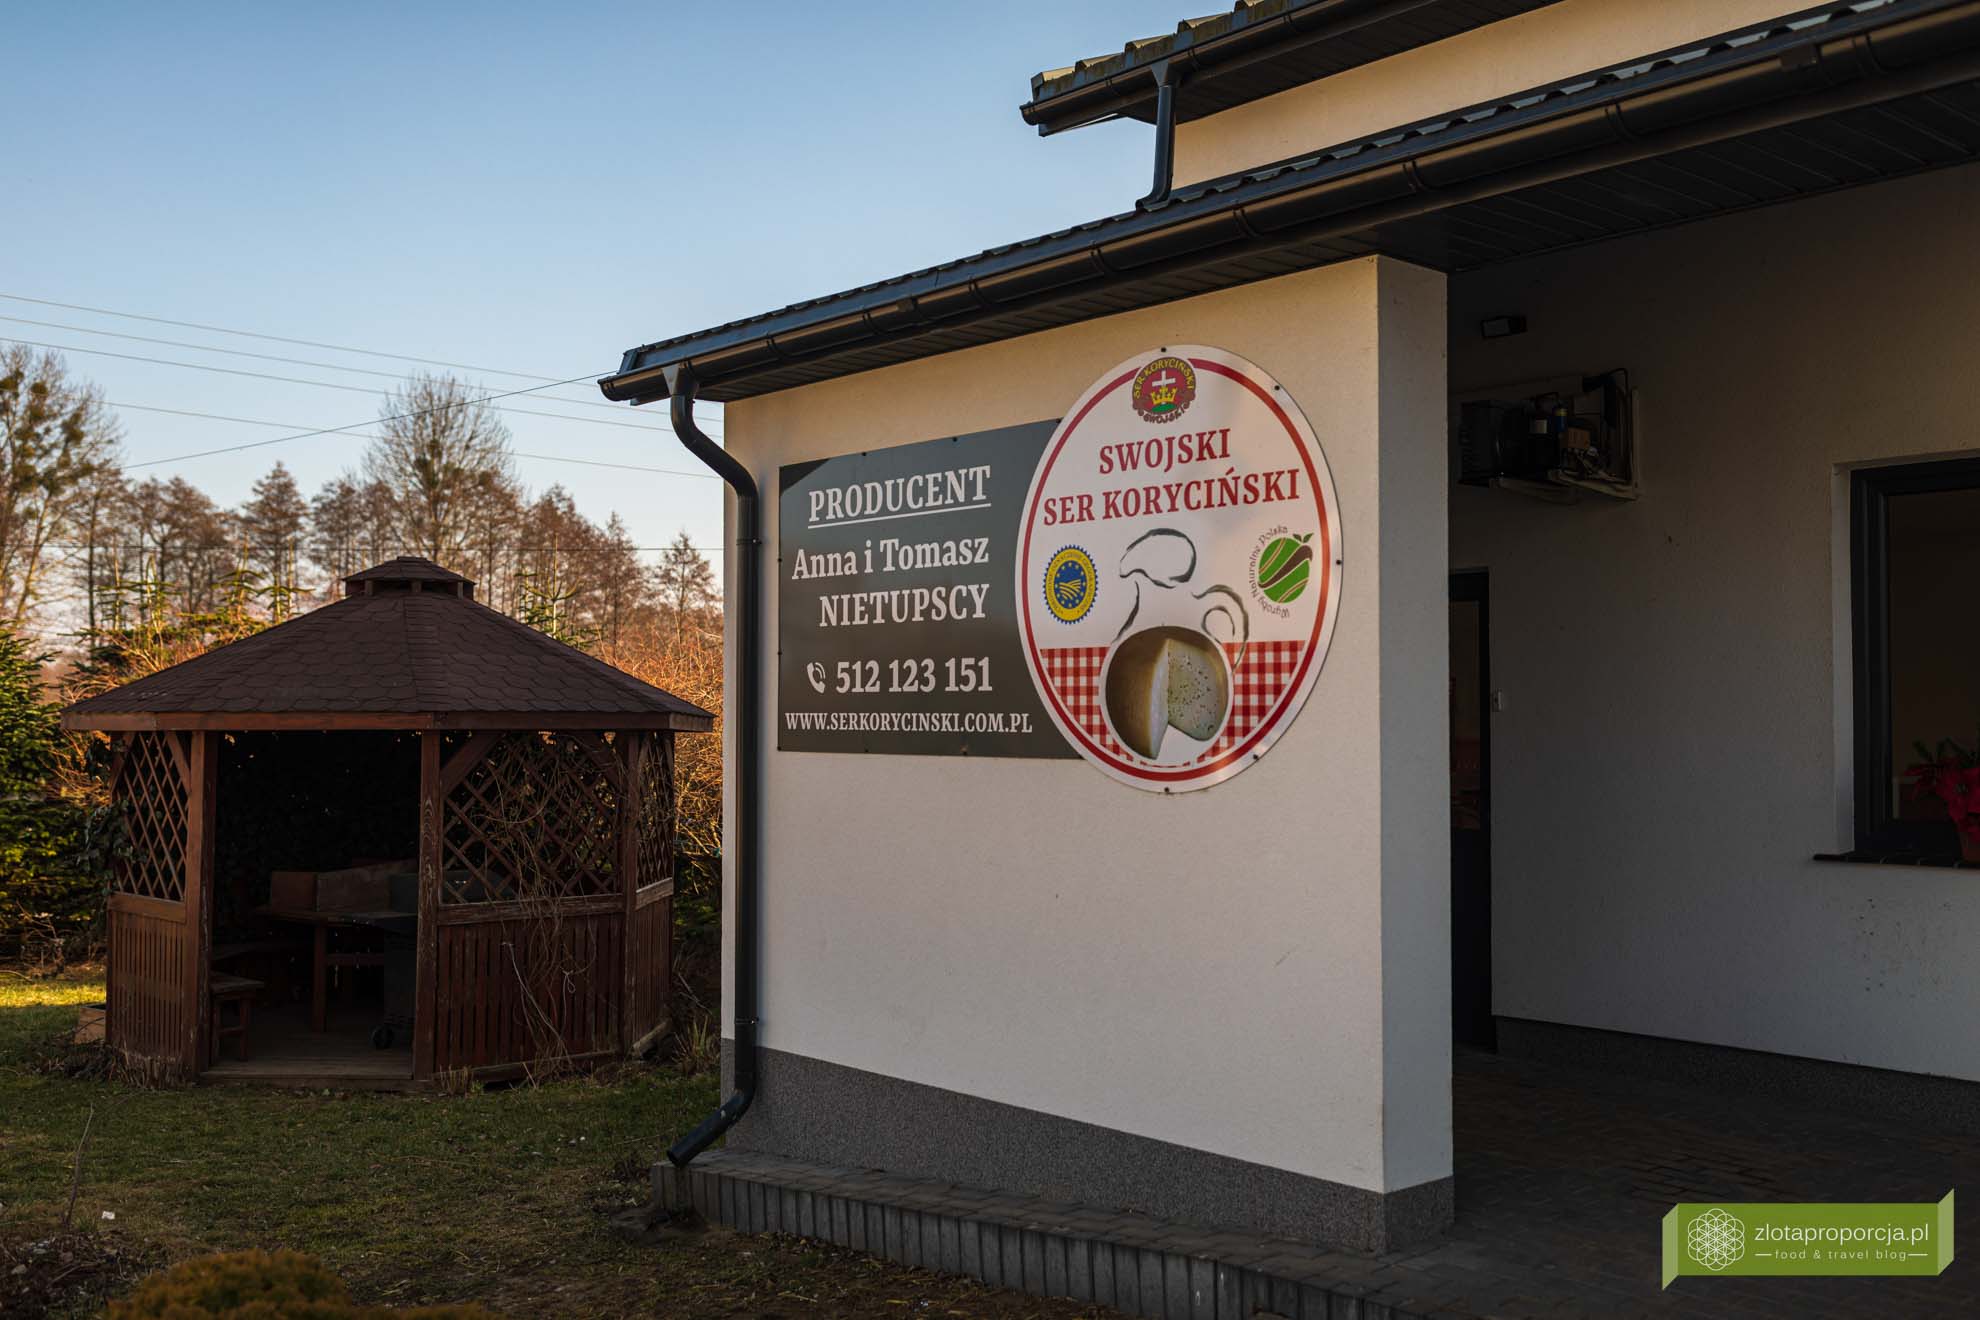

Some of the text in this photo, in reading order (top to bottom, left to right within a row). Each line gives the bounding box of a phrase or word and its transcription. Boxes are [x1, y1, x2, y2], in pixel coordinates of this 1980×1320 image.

[1133, 376, 1146, 399] SER
[1099, 428, 1231, 474] SWOJSKI
[808, 465, 991, 523] PRODUCENT
[1043, 467, 1300, 526] SER KORYCIŃSKI
[791, 537, 990, 580] Anna i Tomasz
[819, 584, 990, 627] NIETUPSCY
[835, 656, 993, 694] 512 123 151
[785, 711, 1033, 734] WWW.SERKORYCINSKI.COM.PL
